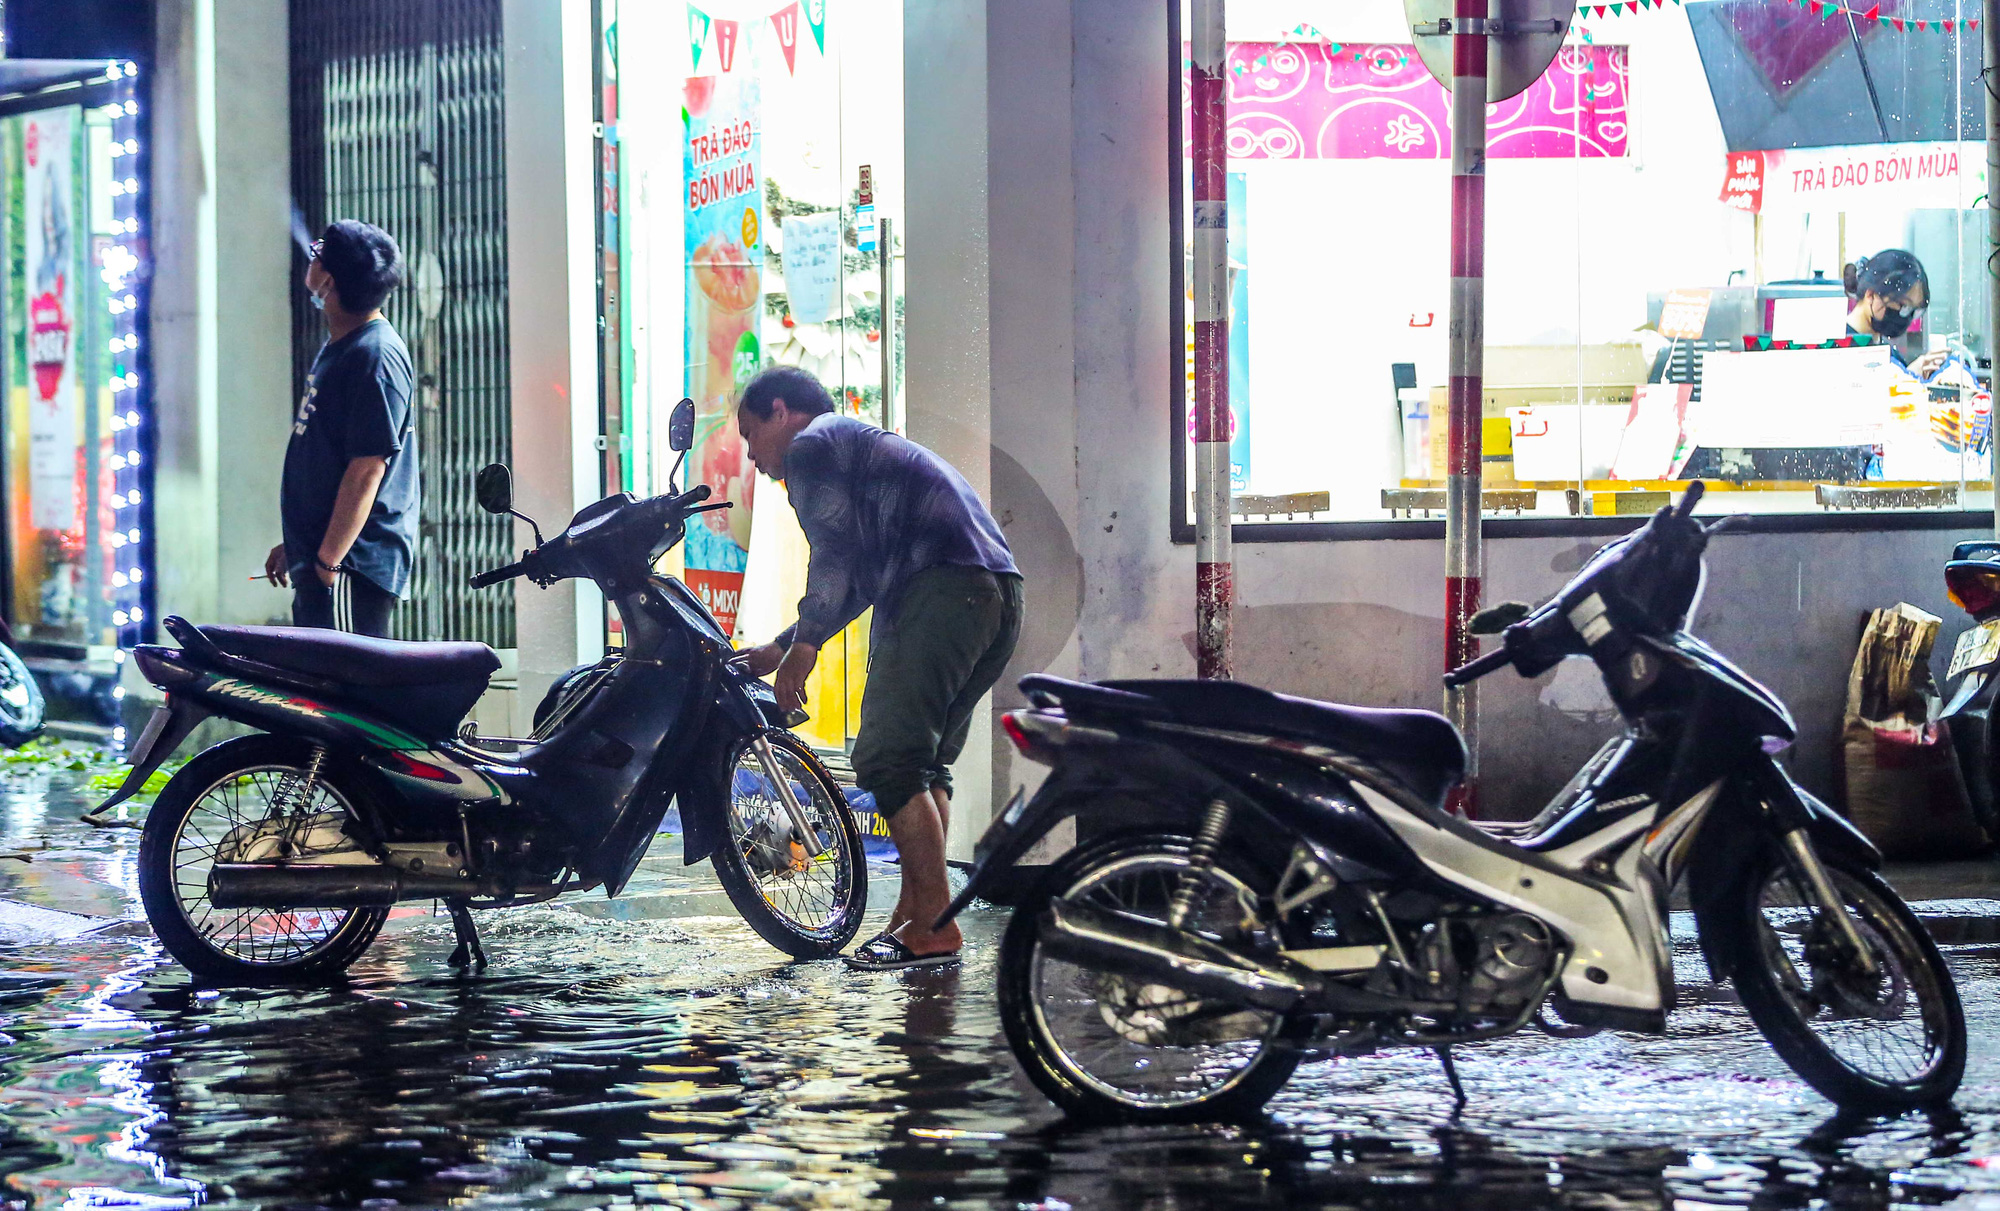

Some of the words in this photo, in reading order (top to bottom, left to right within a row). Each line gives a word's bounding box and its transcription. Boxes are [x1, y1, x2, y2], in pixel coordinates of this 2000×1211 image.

[691, 125, 719, 165] TRÀ
[723, 118, 751, 155] ĐÀO
[690, 168, 719, 208] BỐN
[723, 159, 754, 198] MÙA
[1792, 161, 1825, 192] TRÀ
[1832, 158, 1869, 188] ĐÀO
[1874, 148, 1912, 183] BỐN
[1917, 146, 1958, 179] MÙA
